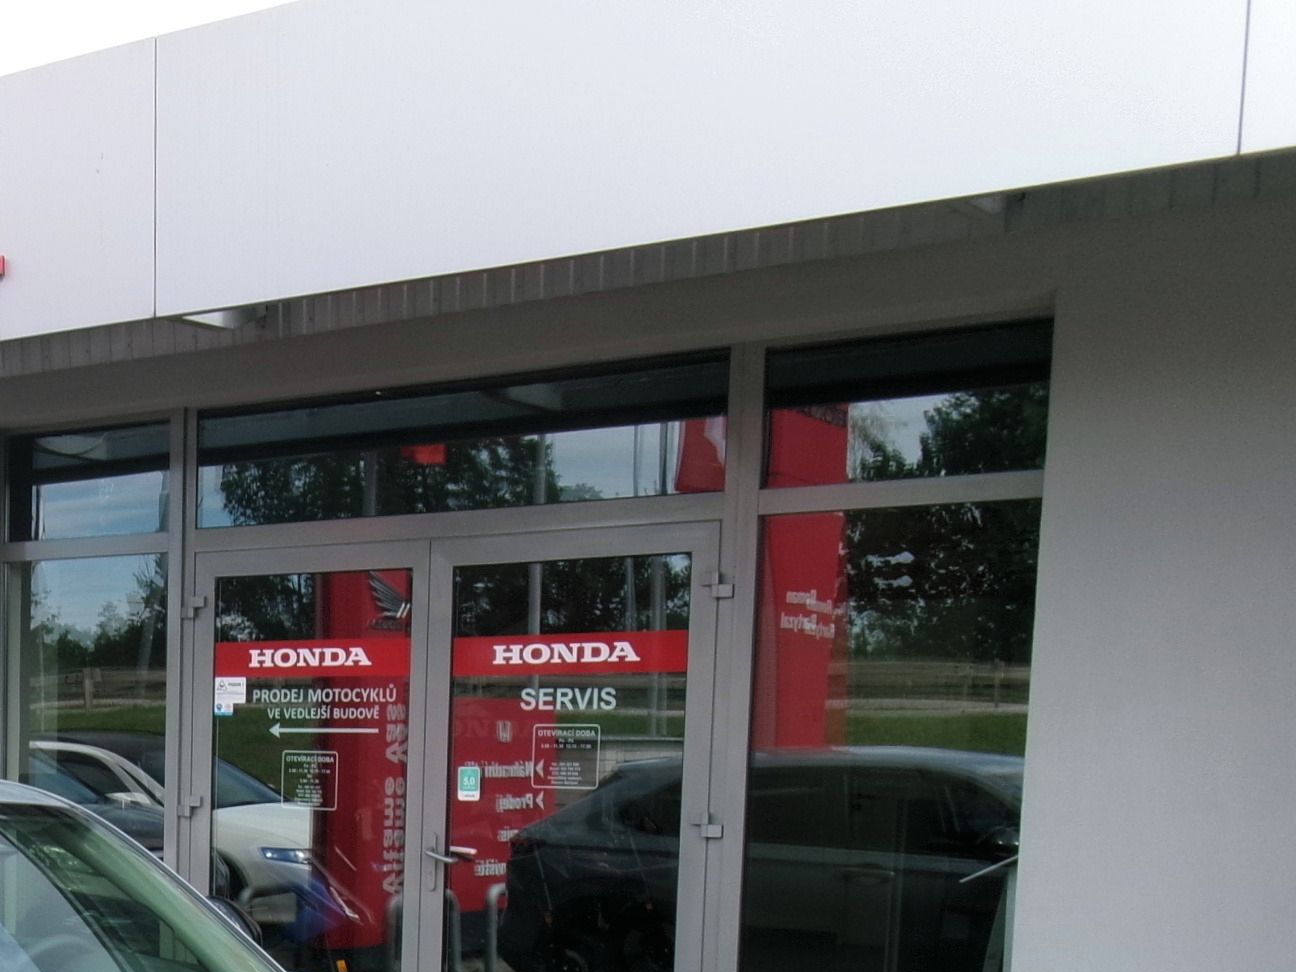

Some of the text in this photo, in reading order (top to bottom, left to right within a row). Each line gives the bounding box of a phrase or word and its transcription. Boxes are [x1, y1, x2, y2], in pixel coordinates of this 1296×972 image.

[249, 647, 372, 667] HONDA
[493, 642, 640, 665] HONDA
[253, 684, 397, 703] PRODEJ MOTOCYKLŮ
[520, 687, 617, 711] SERVIS
[267, 705, 380, 721] VE VEDLEJŠÍ BUDOVĚ
